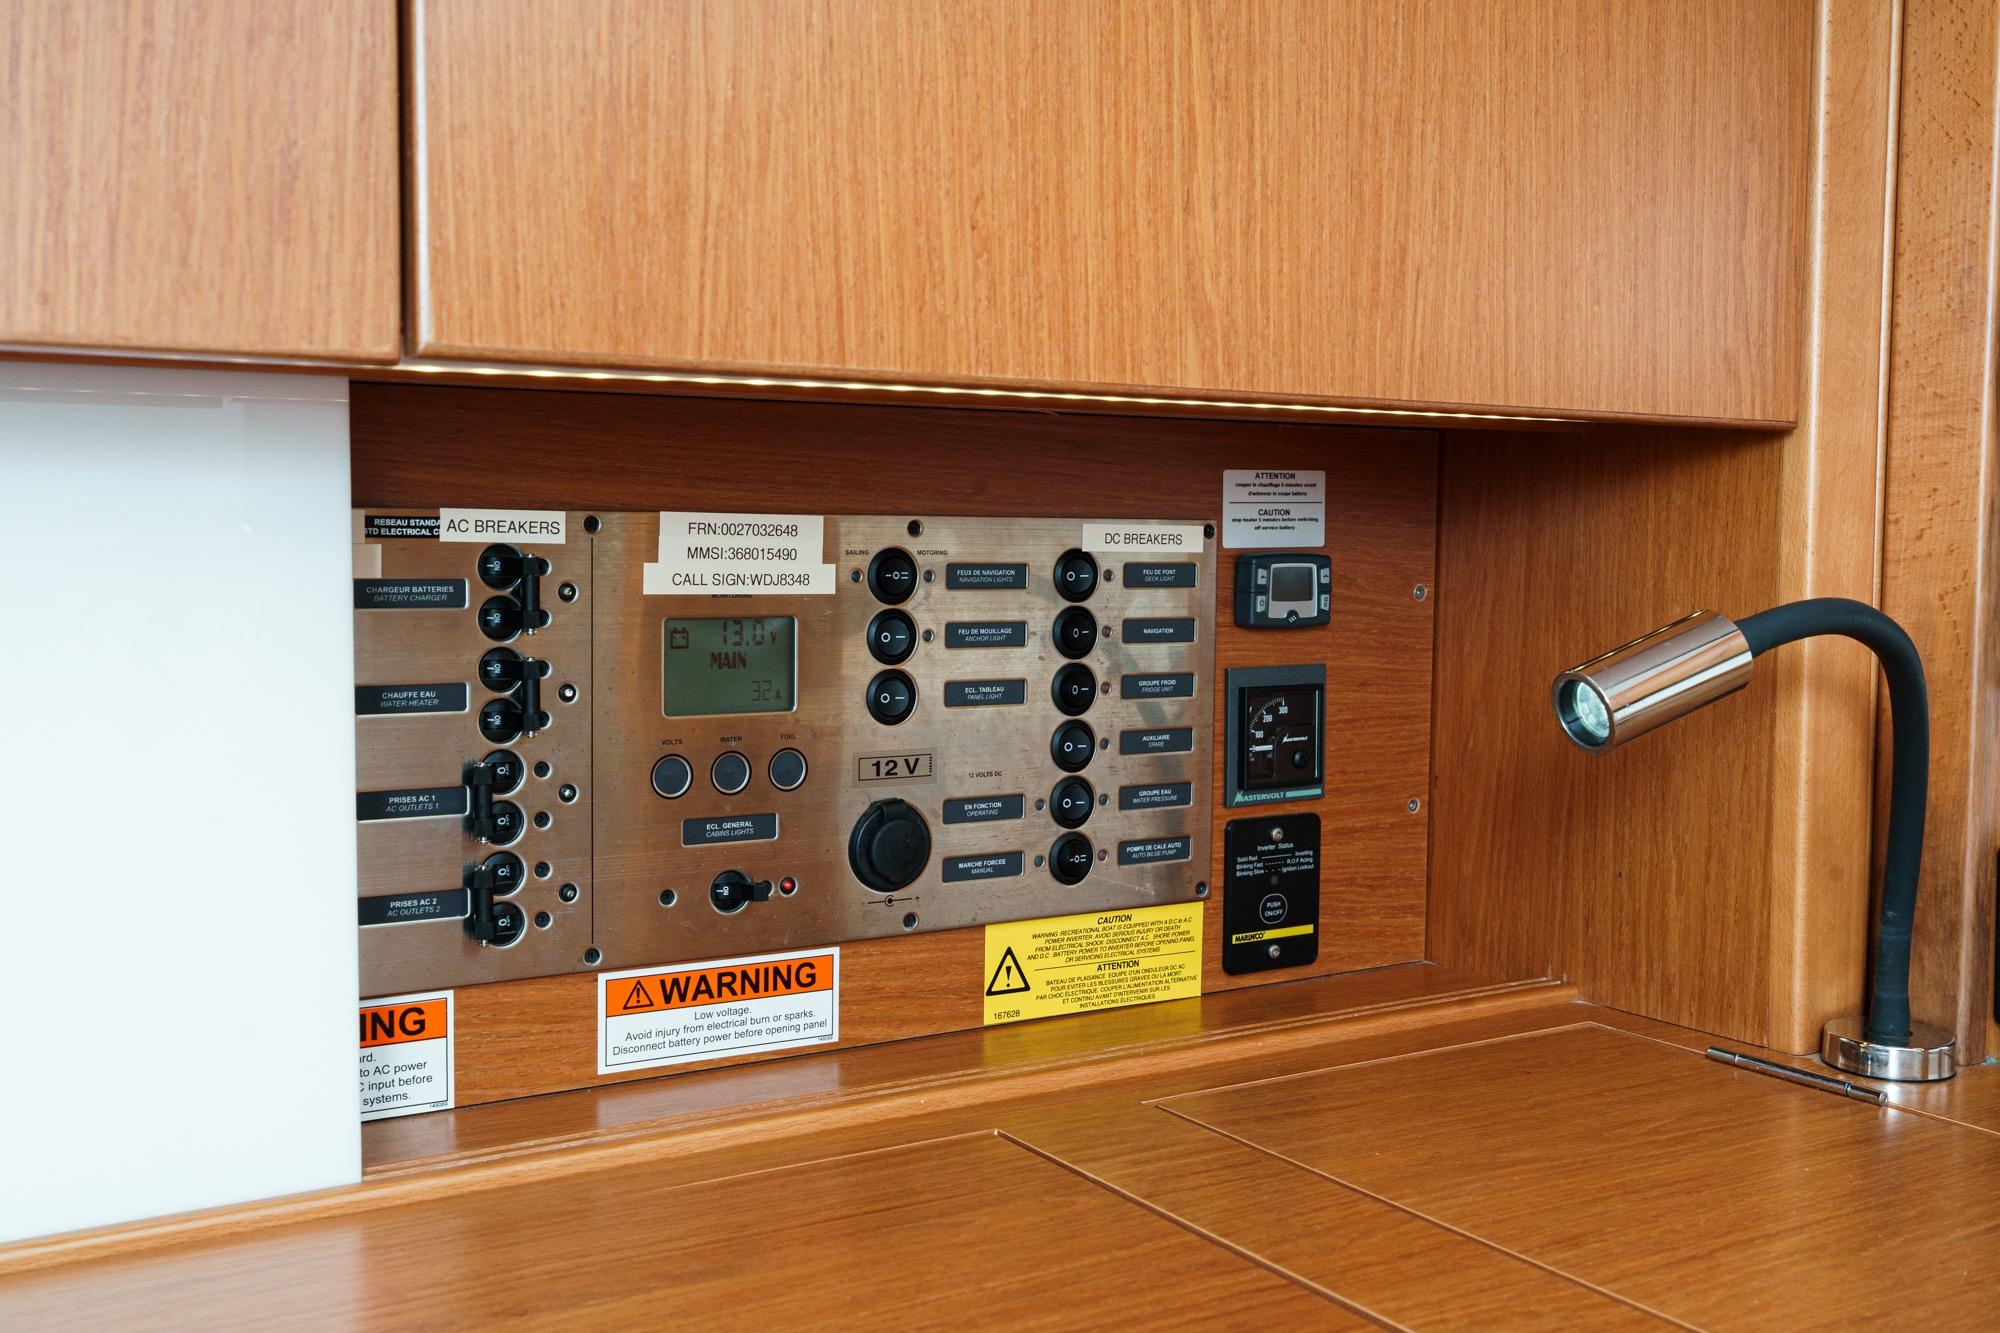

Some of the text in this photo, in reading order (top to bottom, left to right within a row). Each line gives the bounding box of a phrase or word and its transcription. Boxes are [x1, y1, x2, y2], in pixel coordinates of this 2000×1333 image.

[447, 519, 560, 534] AC BREAKERS
[688, 523, 798, 537] FRN:0027032648
[1105, 534, 1183, 545] DC BREAKERS
[687, 547, 797, 560] MMSI:368015490
[672, 573, 810, 586] CALL SIGN:WDJ8348
[710, 652, 746, 669] MAIN
[752, 681, 772, 701] 32
[872, 760, 897, 776] 12
[904, 758, 920, 774] V
[1233, 791, 1284, 805] MASTERVOLT
[722, 821, 753, 829] GENERAL
[731, 828, 753, 836] LIGHTS
[387, 909, 399, 917] AC
[400, 907, 434, 915] OUTLETS
[1097, 914, 1132, 925] CAUTION
[1075, 952, 1103, 962] SERVICING
[1104, 949, 1136, 960] ELECTRICAL
[1136, 947, 1160, 956] SYSTEMS
[1097, 961, 1139, 972] ATTENTION
[660, 962, 816, 1004] WARNING
[1079, 999, 1119, 1008] INSTALLATIONS
[694, 1005, 751, 1020] Low voltage.
[993, 1010, 1020, 1020] 167628
[626, 1010, 815, 1041] Avoid injury from electrical burn or sparks.
[613, 1019, 827, 1055] Disconnect battery power before opening panel
[373, 1065, 390, 1075] AC
[394, 1061, 427, 1075] power
[368, 1079, 395, 1091] input
[399, 1075, 432, 1086] before
[363, 1093, 411, 1107] systems.
